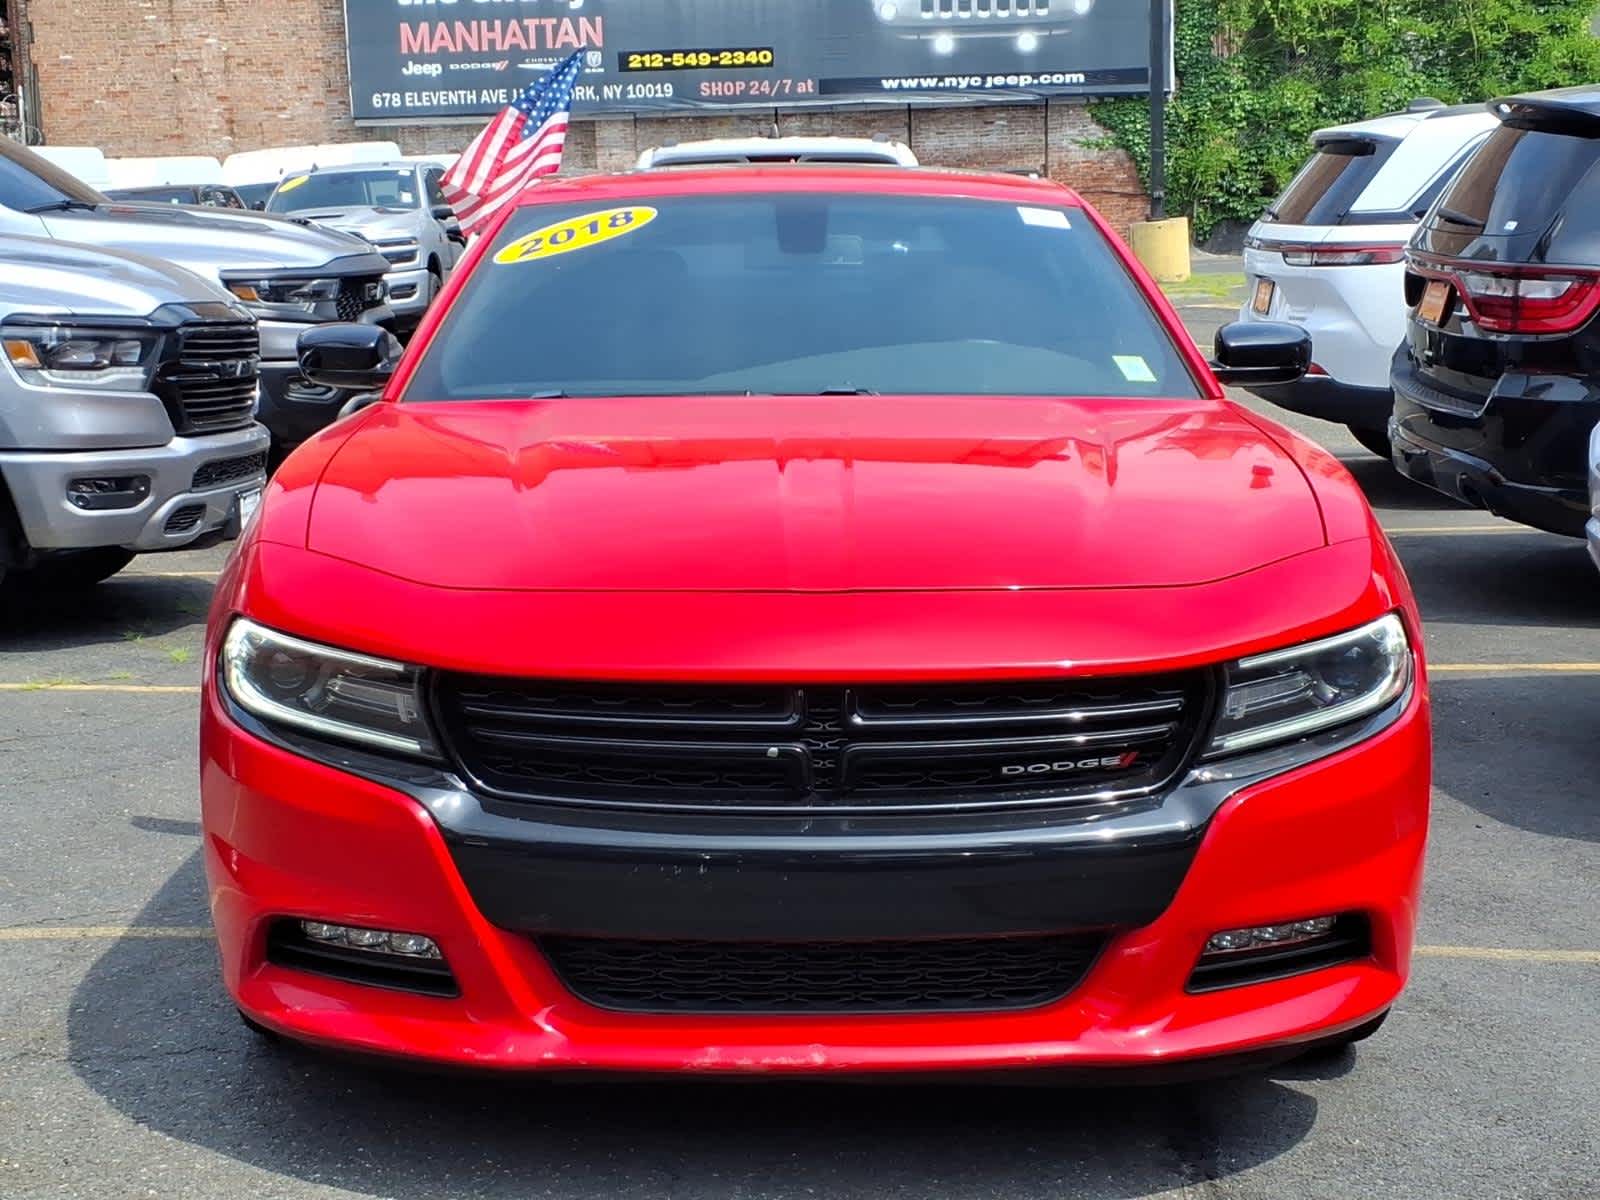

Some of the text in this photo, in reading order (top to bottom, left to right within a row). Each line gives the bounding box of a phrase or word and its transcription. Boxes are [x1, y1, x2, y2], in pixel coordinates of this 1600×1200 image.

[400, 16, 603, 54] MANHATTAN
[401, 61, 442, 77] Jeep
[628, 50, 773, 68] 212-549-2340
[372, 92, 401, 108] 678
[405, 90, 476, 107] ELEVENTH
[481, 89, 508, 104] AVE
[603, 85, 623, 99] NY
[626, 83, 673, 98] 10019
[700, 73, 1085, 97] SHOP 24/7 at www.nycjeep.com
[519, 211, 634, 258] 2018
[1002, 755, 1121, 774] DODGE
